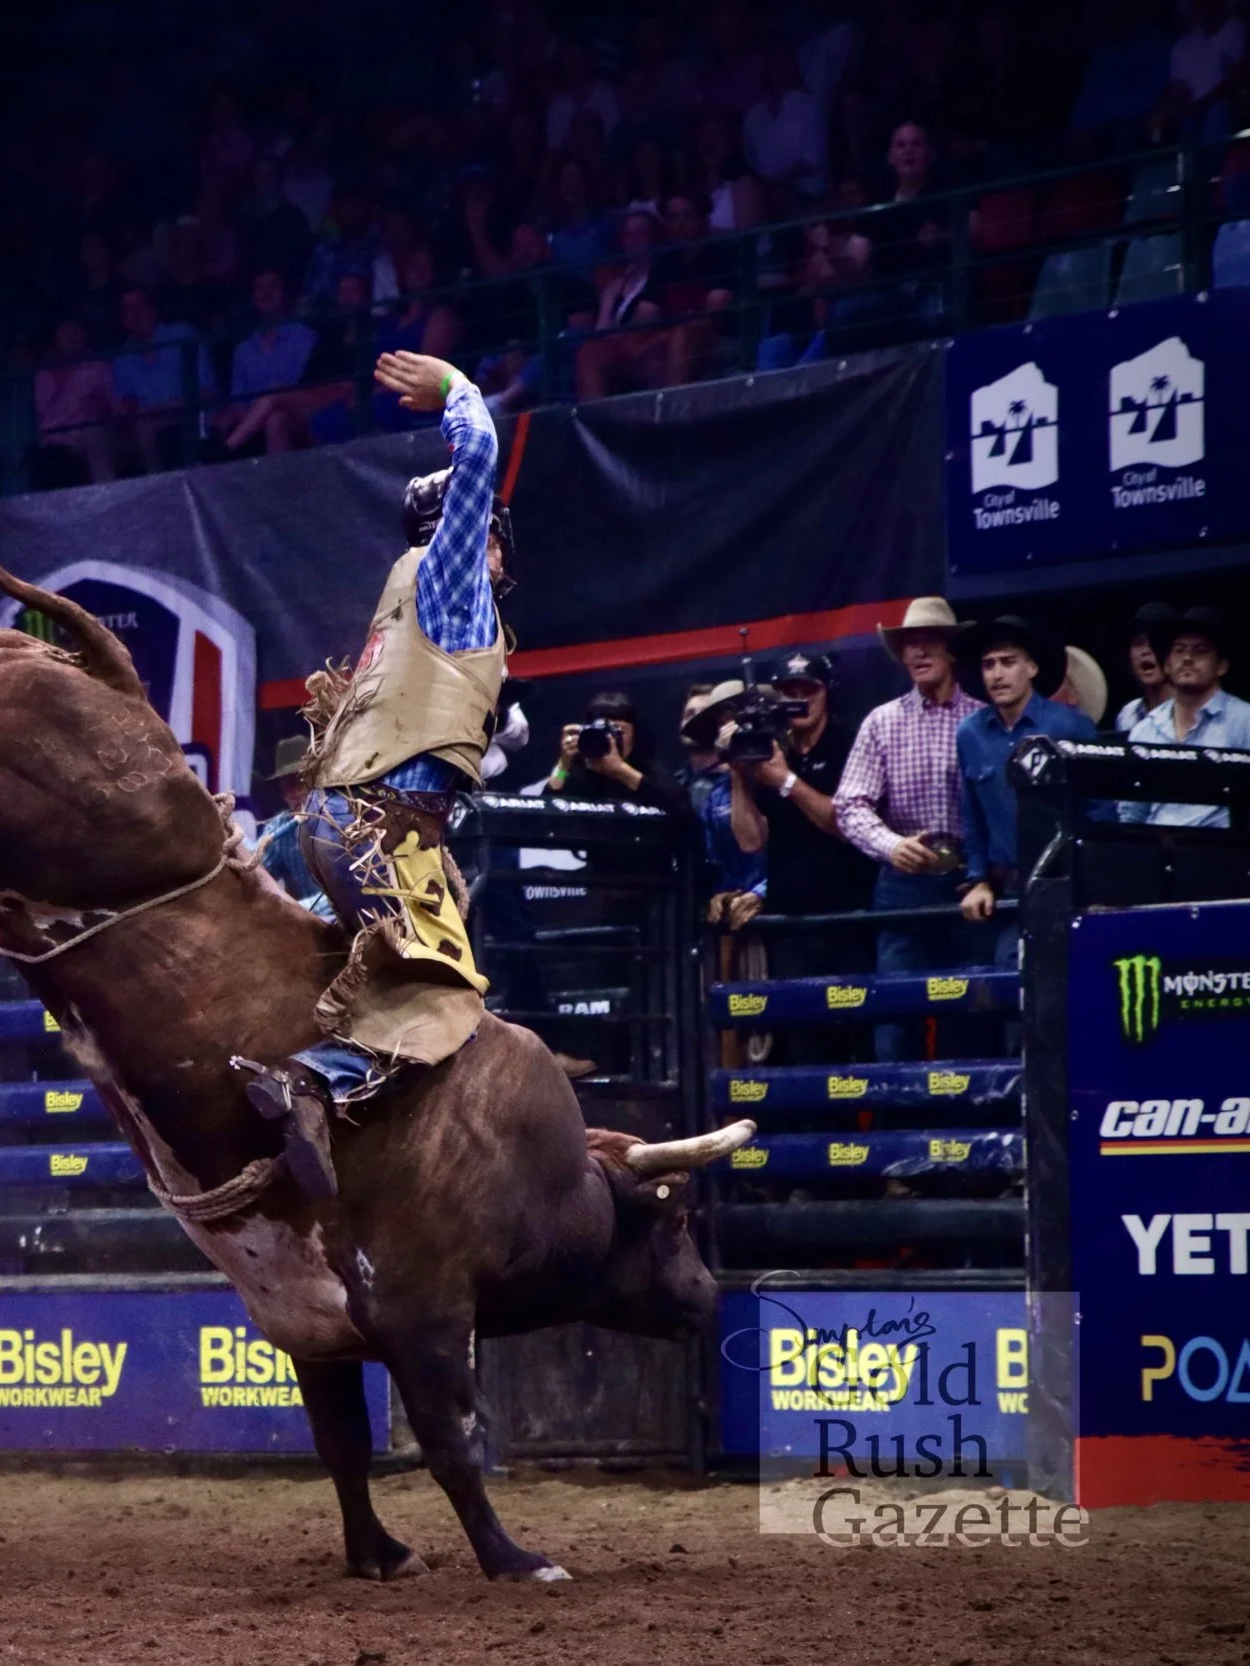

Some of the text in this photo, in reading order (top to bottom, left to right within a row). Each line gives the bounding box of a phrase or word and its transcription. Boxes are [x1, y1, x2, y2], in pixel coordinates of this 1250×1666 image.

[1123, 471, 1143, 486] City
[984, 493, 1002, 508] City
[1111, 476, 1206, 508] Townsville
[973, 498, 1060, 530] Townsville
[929, 977, 969, 998] Bisley
[1163, 970, 1250, 996] MONSTE
[729, 994, 767, 1013] Bisley
[827, 986, 867, 1006] Bisley
[730, 1080, 768, 1099] Bisley
[828, 1077, 868, 1096] Bisley
[929, 1072, 970, 1093] Bisley
[46, 1091, 83, 1110] Bisley
[1100, 1097, 1250, 1137] can-a
[828, 1143, 869, 1163] Bisley
[930, 1139, 970, 1160] Bisley
[51, 1154, 88, 1173] Bisley
[1121, 1213, 1250, 1275] YET
[200, 1326, 299, 1383] Bisl
[769, 1328, 918, 1400] Bisley
[201, 1387, 305, 1408] WORKWEA
